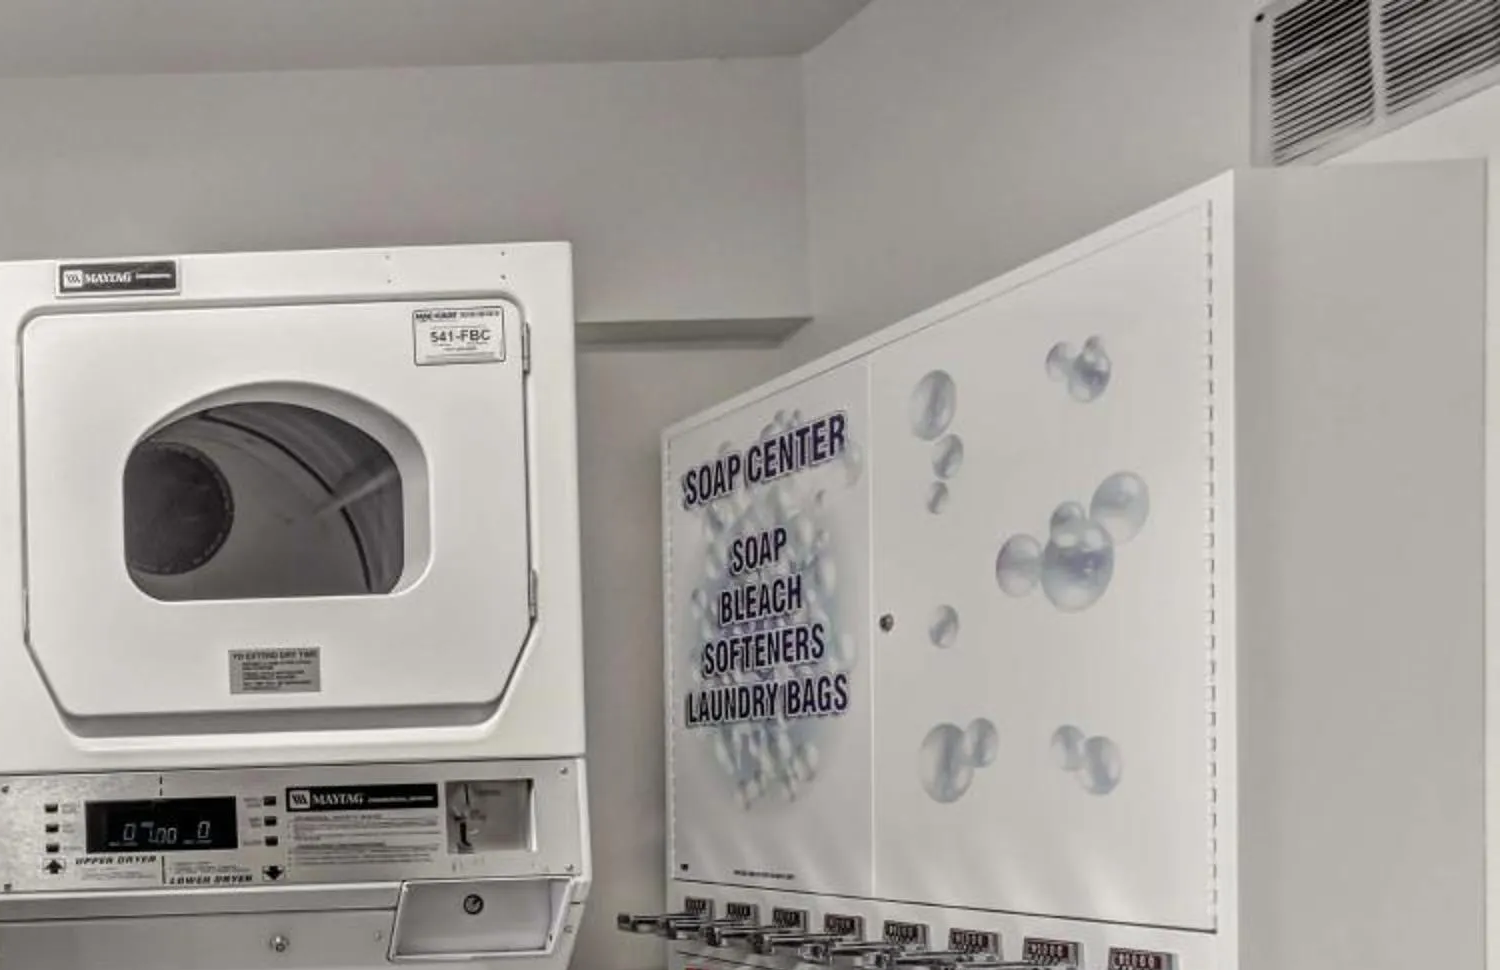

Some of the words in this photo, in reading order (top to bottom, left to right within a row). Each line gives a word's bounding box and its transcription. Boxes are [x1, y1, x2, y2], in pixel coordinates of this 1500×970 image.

[85, 271, 132, 283] MAYTAG
[430, 329, 491, 342] 541-FBC
[685, 453, 741, 505] SOAP
[748, 413, 845, 483] CENTER
[732, 527, 787, 573] SOAP
[721, 573, 802, 623] BLEACH
[704, 623, 825, 675] SOFTENERS
[689, 682, 779, 723] LAUNDRY
[788, 674, 847, 715] BAGS
[311, 792, 364, 806] MAYTAG
[75, 856, 114, 865] UPPER
[117, 855, 157, 864] DRYER
[169, 875, 211, 885] LOWER
[214, 874, 253, 884] DRYER
